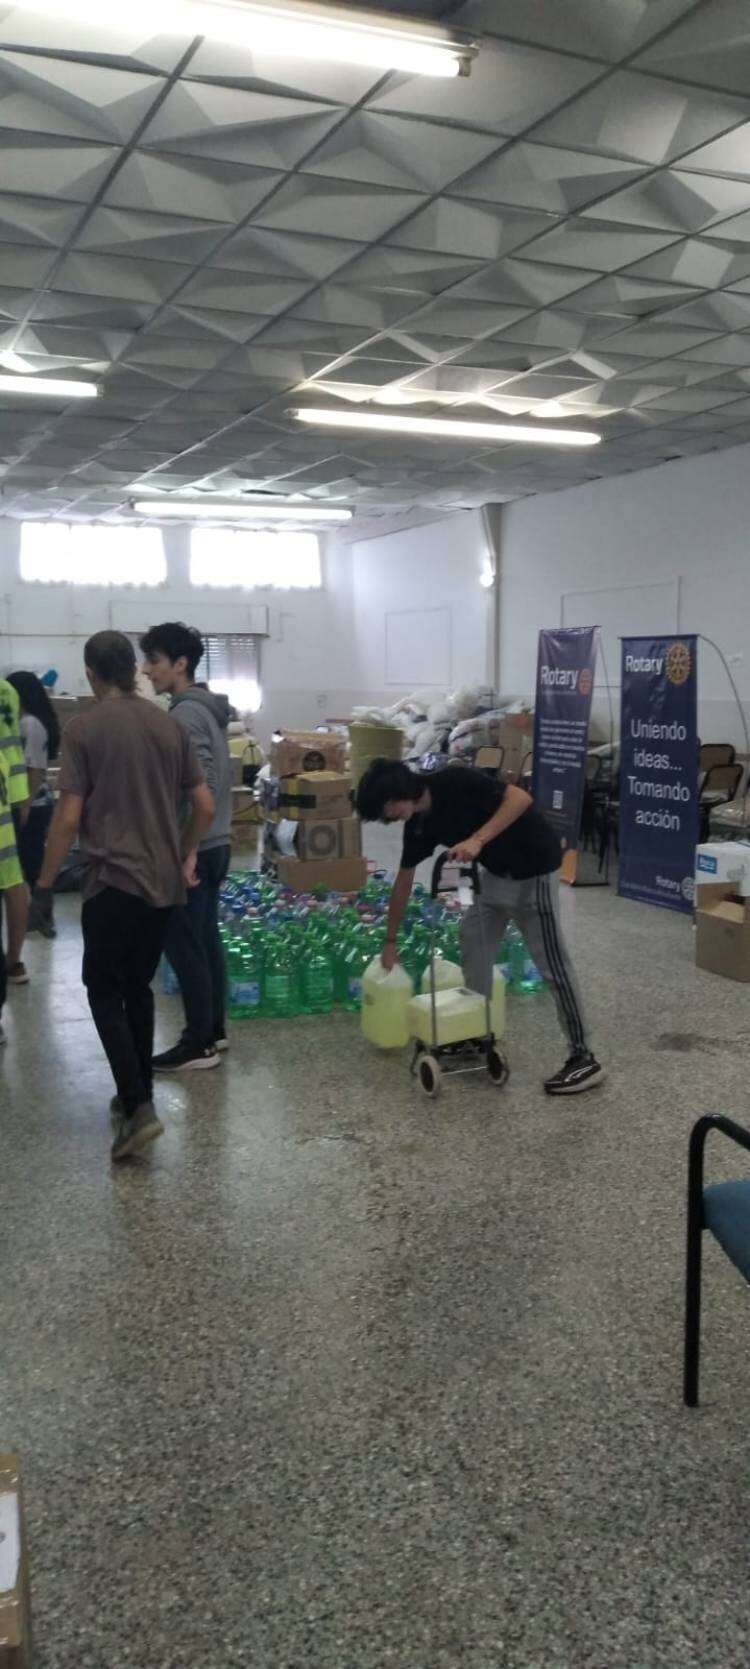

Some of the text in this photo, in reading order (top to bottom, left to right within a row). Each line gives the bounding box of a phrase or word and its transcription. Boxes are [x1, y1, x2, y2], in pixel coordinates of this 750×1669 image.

[625, 655, 663, 675] Rotary
[541, 665, 579, 690] Rotary
[630, 718, 687, 741] Uniendo
[627, 775, 690, 802] Tomando
[635, 808, 680, 831] acción
